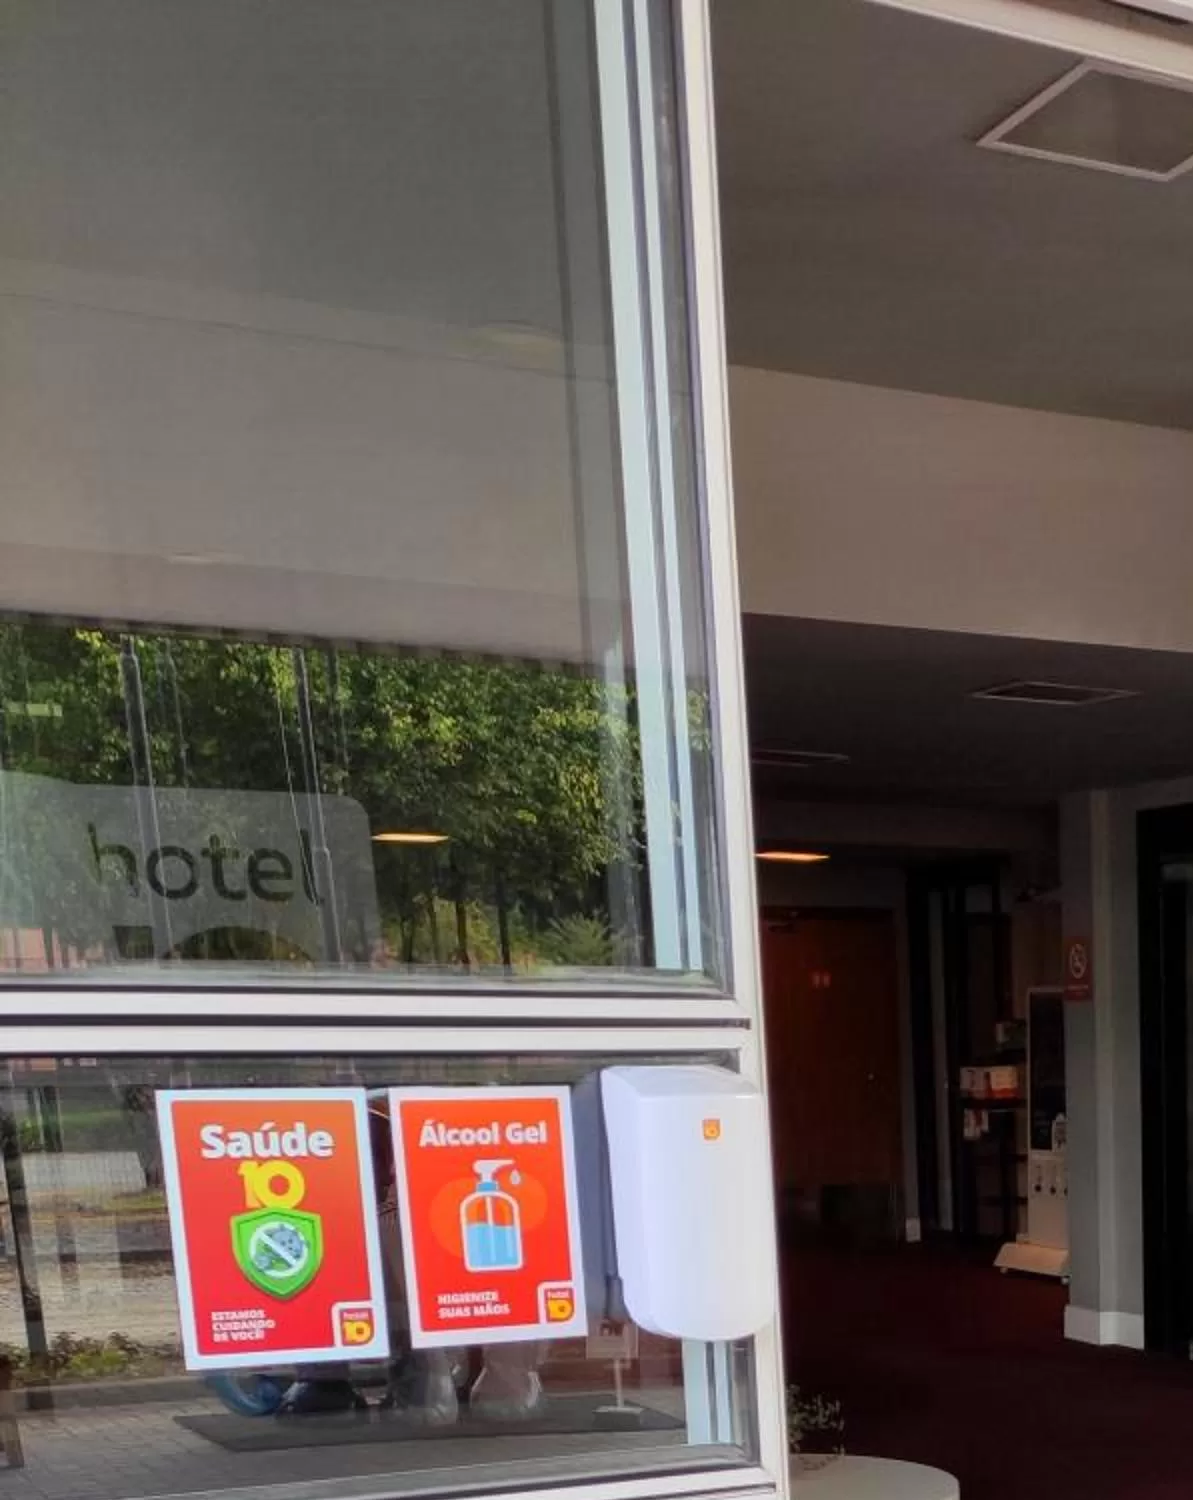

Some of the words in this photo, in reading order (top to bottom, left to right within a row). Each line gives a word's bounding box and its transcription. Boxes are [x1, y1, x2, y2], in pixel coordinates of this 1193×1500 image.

[88, 822, 325, 906] hotel
[200, 1121, 335, 1159] Saúde
[418, 1119, 500, 1148] Álcool
[505, 1120, 548, 1145] Gel
[237, 1159, 305, 1209] 10
[437, 1289, 499, 1305] HIGIENIZE
[437, 1305, 471, 1319] SUAS
[473, 1302, 512, 1317] MÃOS
